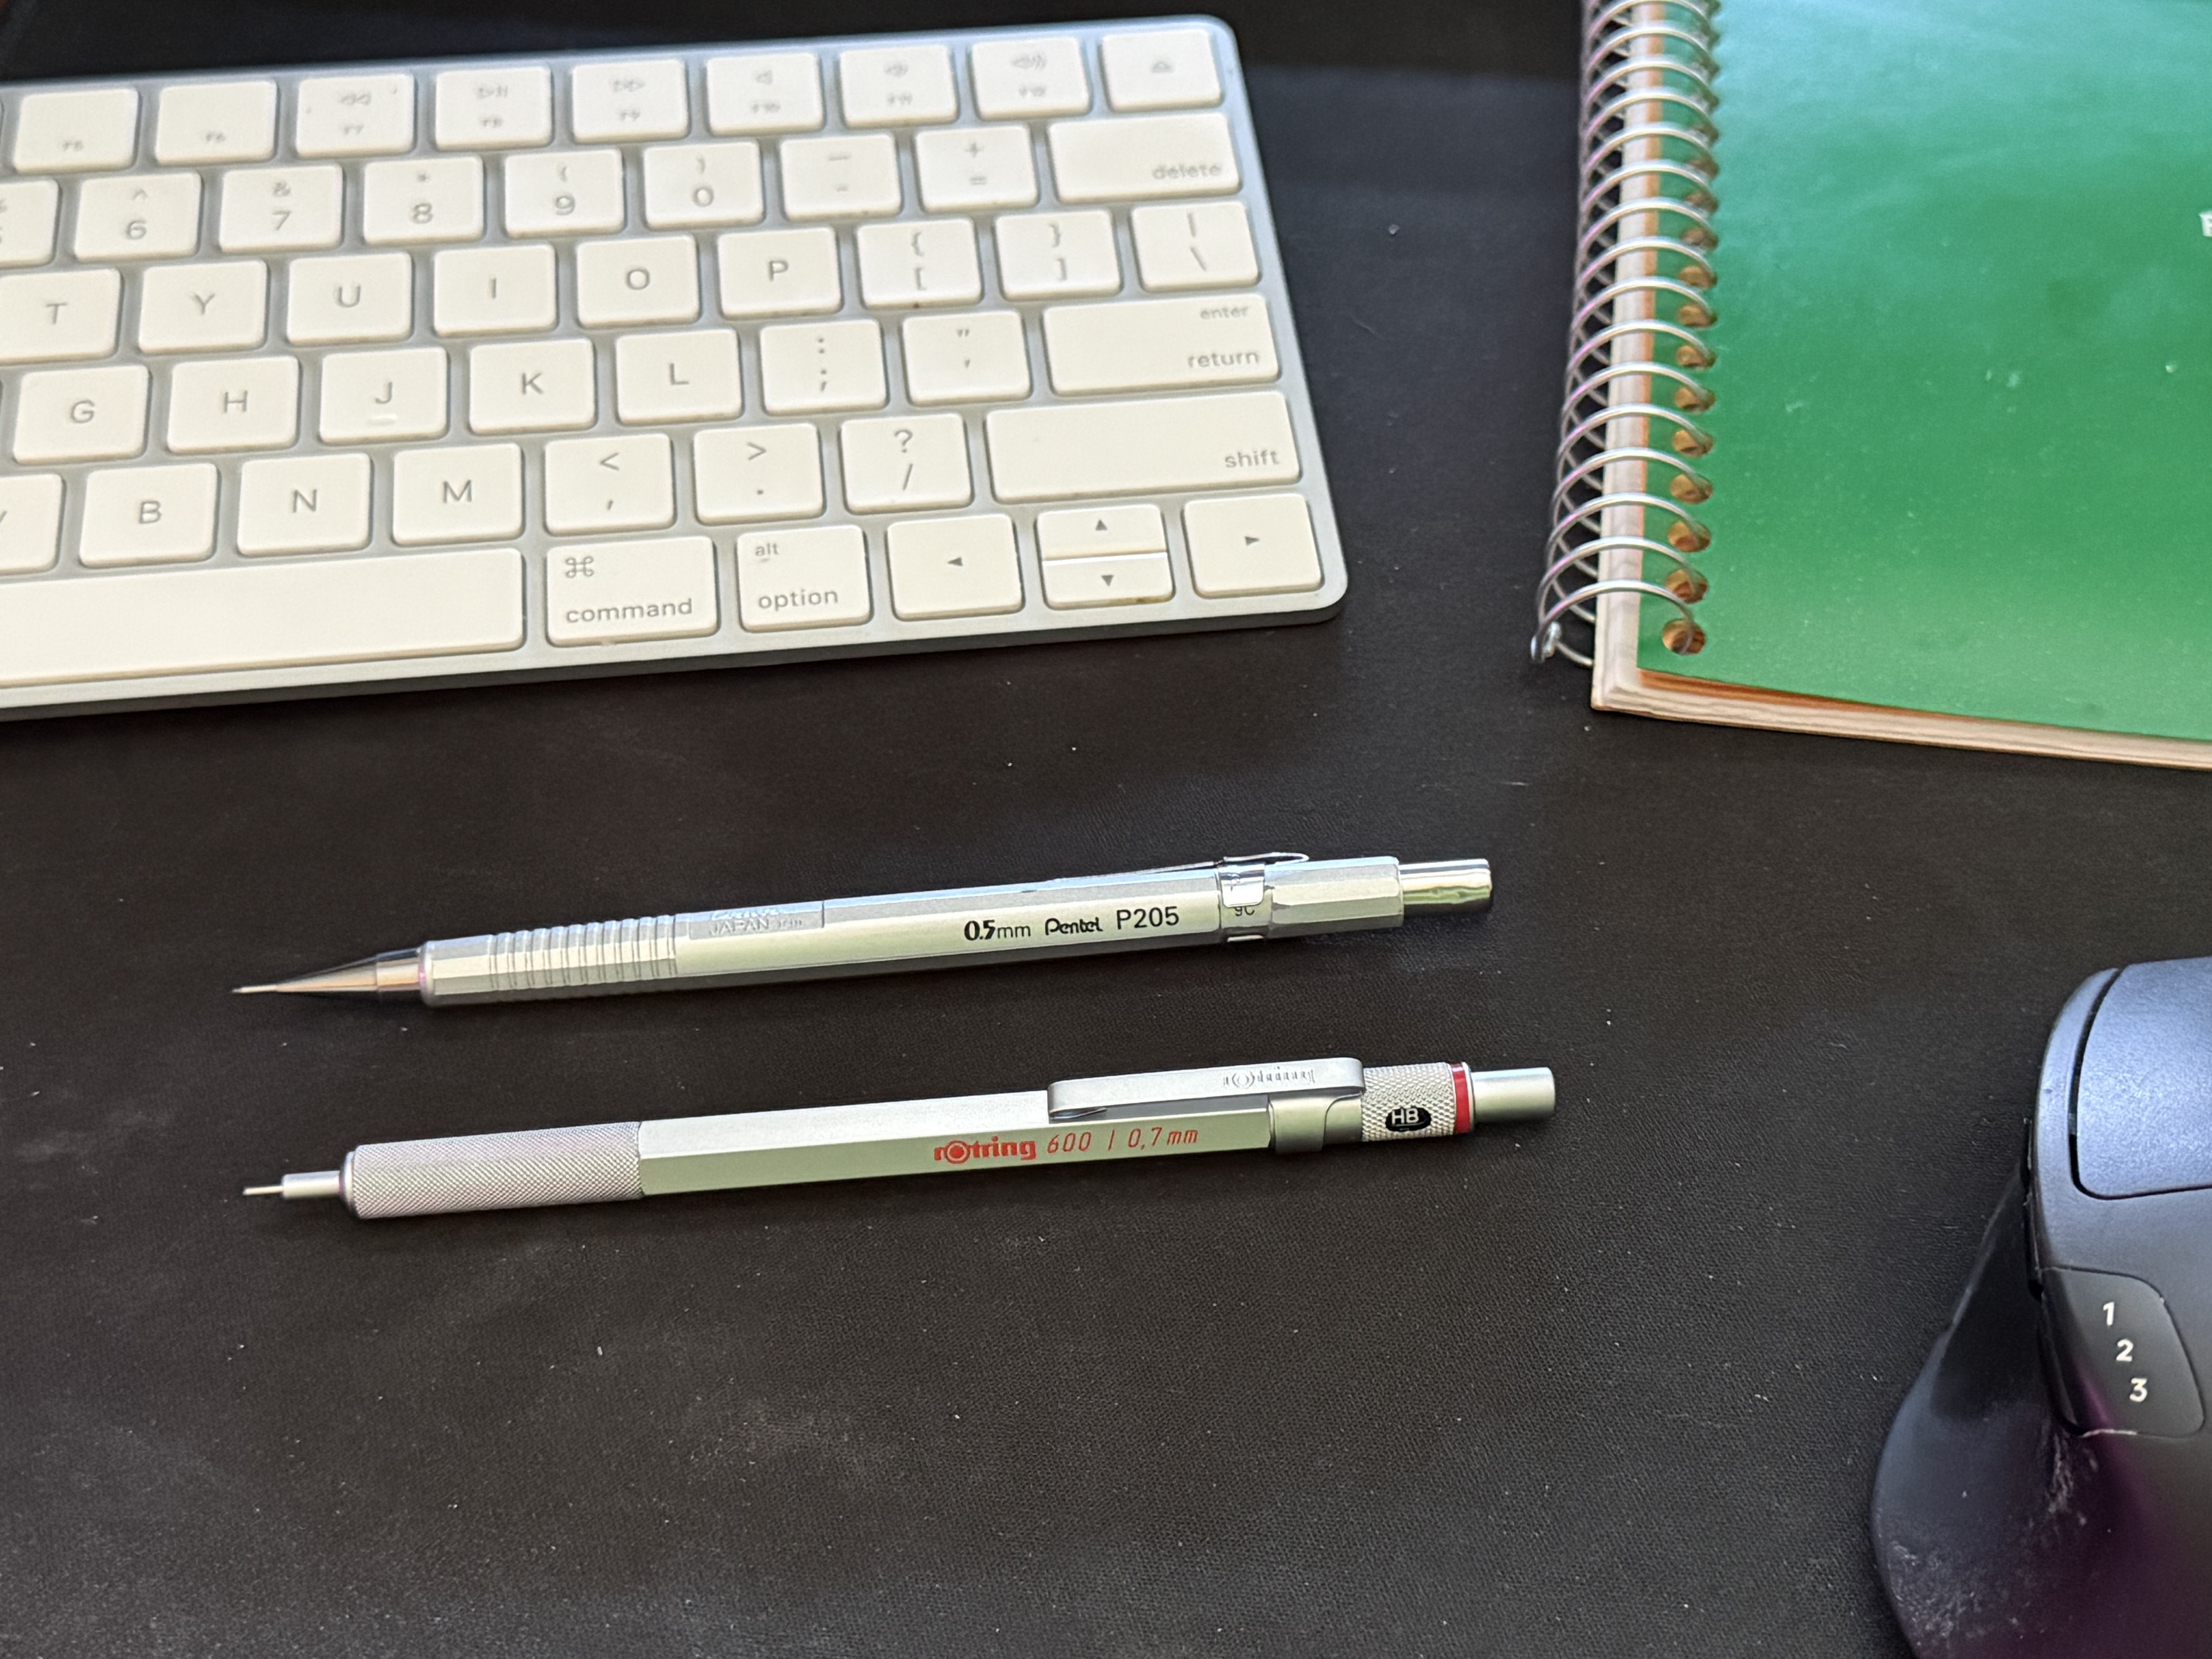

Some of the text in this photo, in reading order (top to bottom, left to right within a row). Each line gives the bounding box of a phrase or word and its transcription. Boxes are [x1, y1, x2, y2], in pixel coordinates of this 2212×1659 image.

[1151, 163, 1221, 180] delete
[412, 202, 433, 223] 8
[554, 194, 576, 215] 9
[124, 219, 147, 239] 6
[273, 209, 292, 231] 7
[625, 267, 651, 290] O
[768, 259, 789, 281] P
[914, 266, 924, 290] [
[1056, 257, 1068, 281] ]
[192, 294, 215, 315] Y
[336, 285, 361, 308] U
[45, 302, 67, 325] T
[1200, 306, 1248, 319] enter
[1187, 351, 1259, 368] return
[521, 373, 543, 395] K
[669, 363, 689, 385] L
[820, 369, 827, 392] ;
[222, 390, 248, 413] H
[374, 381, 393, 405] J
[69, 399, 95, 424] G
[747, 442, 767, 461] >
[893, 428, 913, 453] ?
[599, 452, 619, 471] <
[1224, 449, 1279, 468] shift
[902, 463, 914, 490] /
[292, 489, 318, 513] N
[442, 479, 472, 503] M
[137, 500, 162, 524] B
[755, 543, 778, 556] alt
[565, 598, 692, 623] command
[757, 589, 838, 611] option
[709, 915, 769, 936] JAPAN
[964, 906, 1180, 941] 0.5mm Pentel P205
[1391, 1108, 1419, 1124] HB
[934, 1135, 1037, 1164] rotring
[1047, 1131, 1092, 1154] 600
[2103, 1301, 2115, 1326] 1
[2116, 1338, 2134, 1362] 2
[2130, 1377, 2148, 1403] 3
